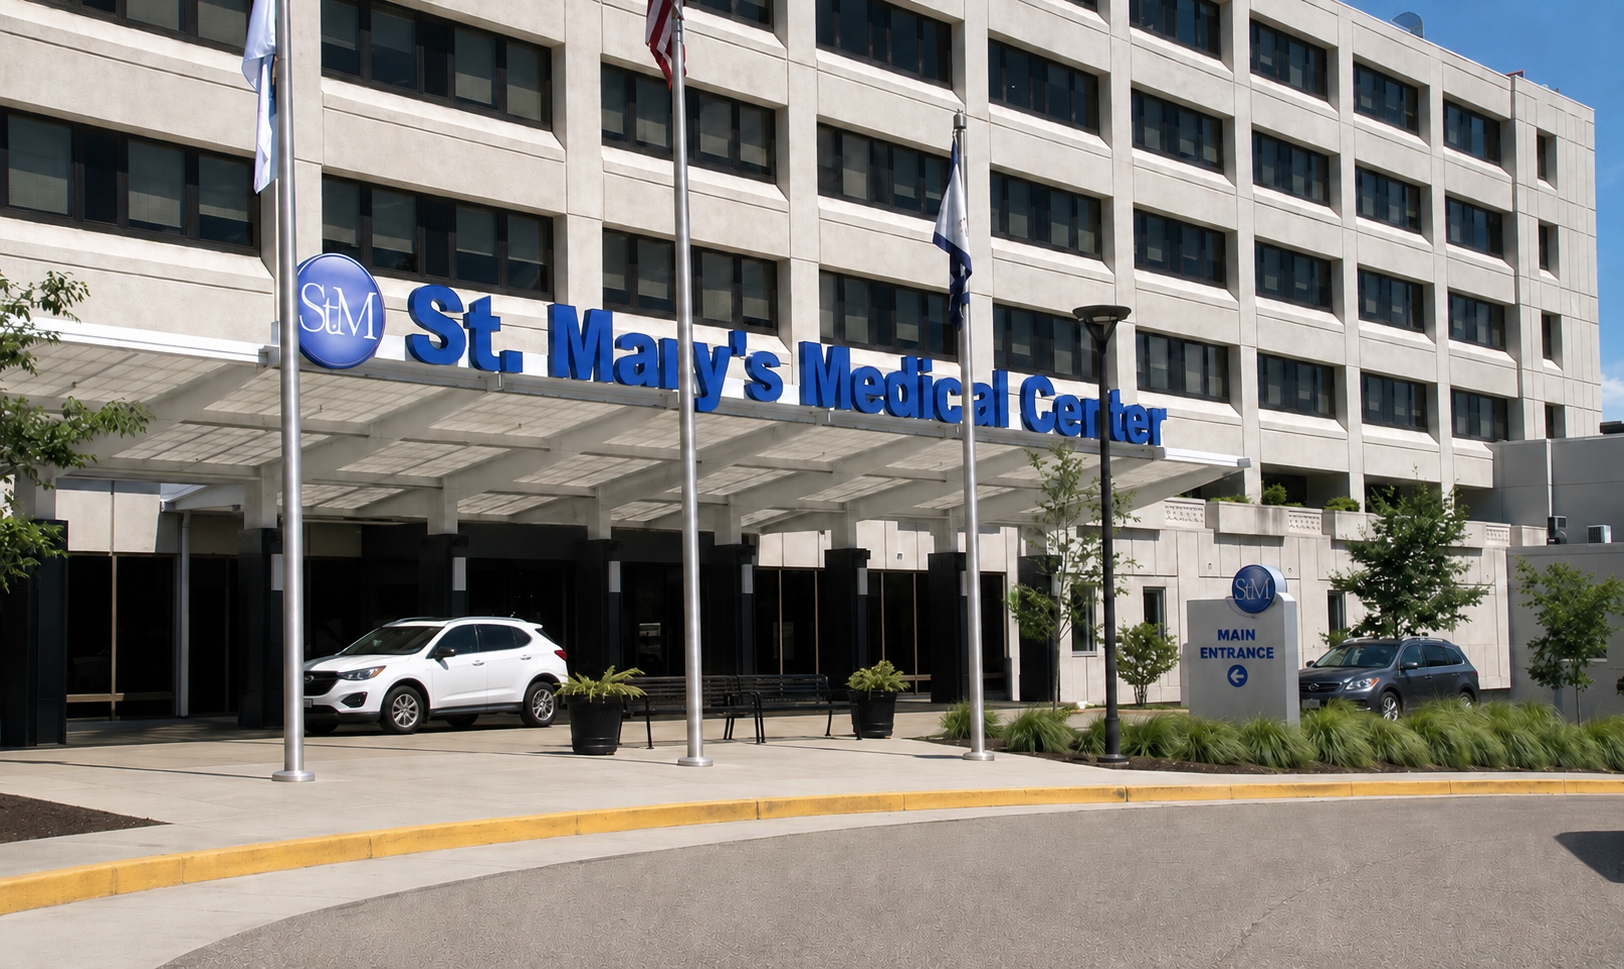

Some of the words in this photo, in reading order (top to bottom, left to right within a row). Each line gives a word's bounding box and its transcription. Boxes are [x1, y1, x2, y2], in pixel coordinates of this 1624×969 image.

[405, 284, 523, 374] St.
[799, 341, 1010, 429] Medical
[1019, 374, 1168, 446] Center
[1217, 628, 1256, 641] MAIN
[1200, 646, 1274, 659] ENTRANCE
